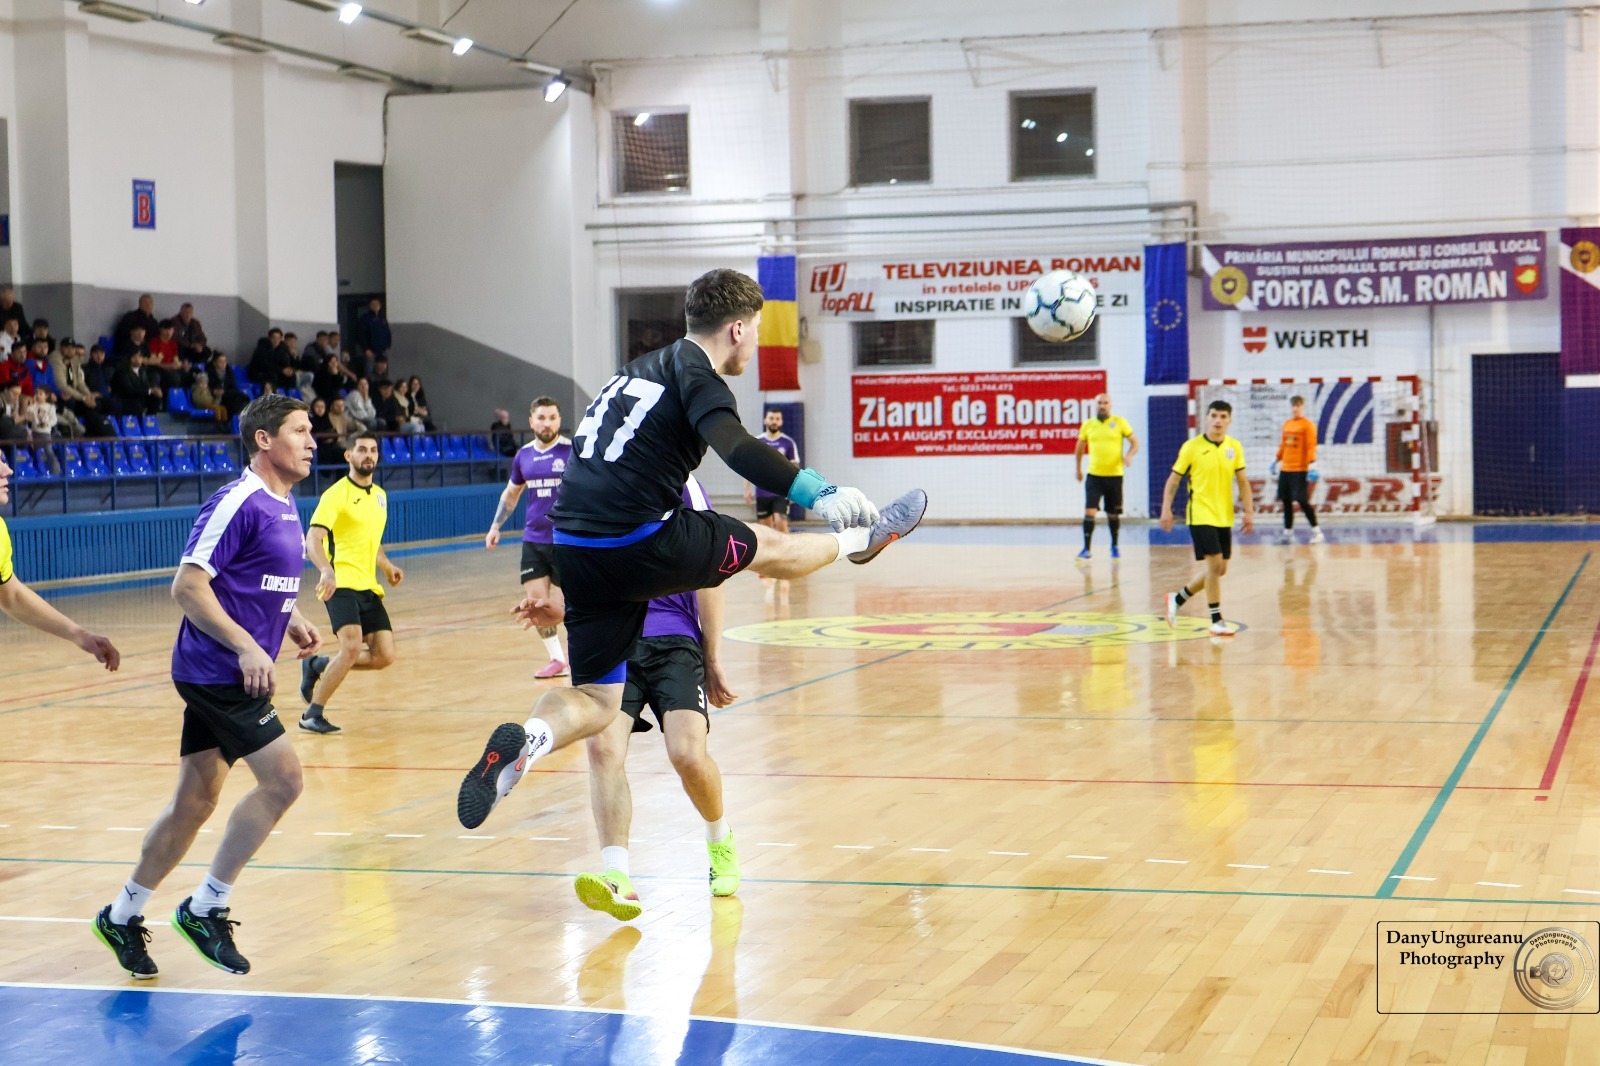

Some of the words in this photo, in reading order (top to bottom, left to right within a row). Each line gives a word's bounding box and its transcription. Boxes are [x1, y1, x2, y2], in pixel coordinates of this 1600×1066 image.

[138, 193, 150, 224] B
[1224, 249, 1283, 264] PRIMĂRIA
[1285, 247, 1369, 263] MUNICIPIULUI
[1371, 245, 1416, 260] ROMAN
[1433, 241, 1498, 257] CONSILIUL
[1500, 239, 1541, 253] LOCAL
[883, 259, 1043, 279] TELEVIZIUNEA
[1302, 262, 1377, 275] HANDBALUL
[1379, 261, 1396, 272] DE
[1252, 279, 1329, 309] FORȚA
[1334, 276, 1409, 304] C.S.M.
[1415, 270, 1507, 301] ROMAN
[895, 298, 995, 313] INSPIRATIE
[1002, 298, 1021, 310] IN
[1112, 294, 1128, 306] ZI
[1275, 329, 1368, 349] WÜRTH
[859, 395, 942, 428] Ziarul
[952, 394, 987, 426] de
[854, 432, 871, 442] DE
[873, 432, 890, 442] LA
[893, 431, 900, 441] 1
[902, 430, 954, 441] AUGUST
[956, 429, 1018, 441] EXCLUSIV
[1021, 429, 1037, 439] PE
[914, 442, 1043, 453] www.ziarulderoman.ro
